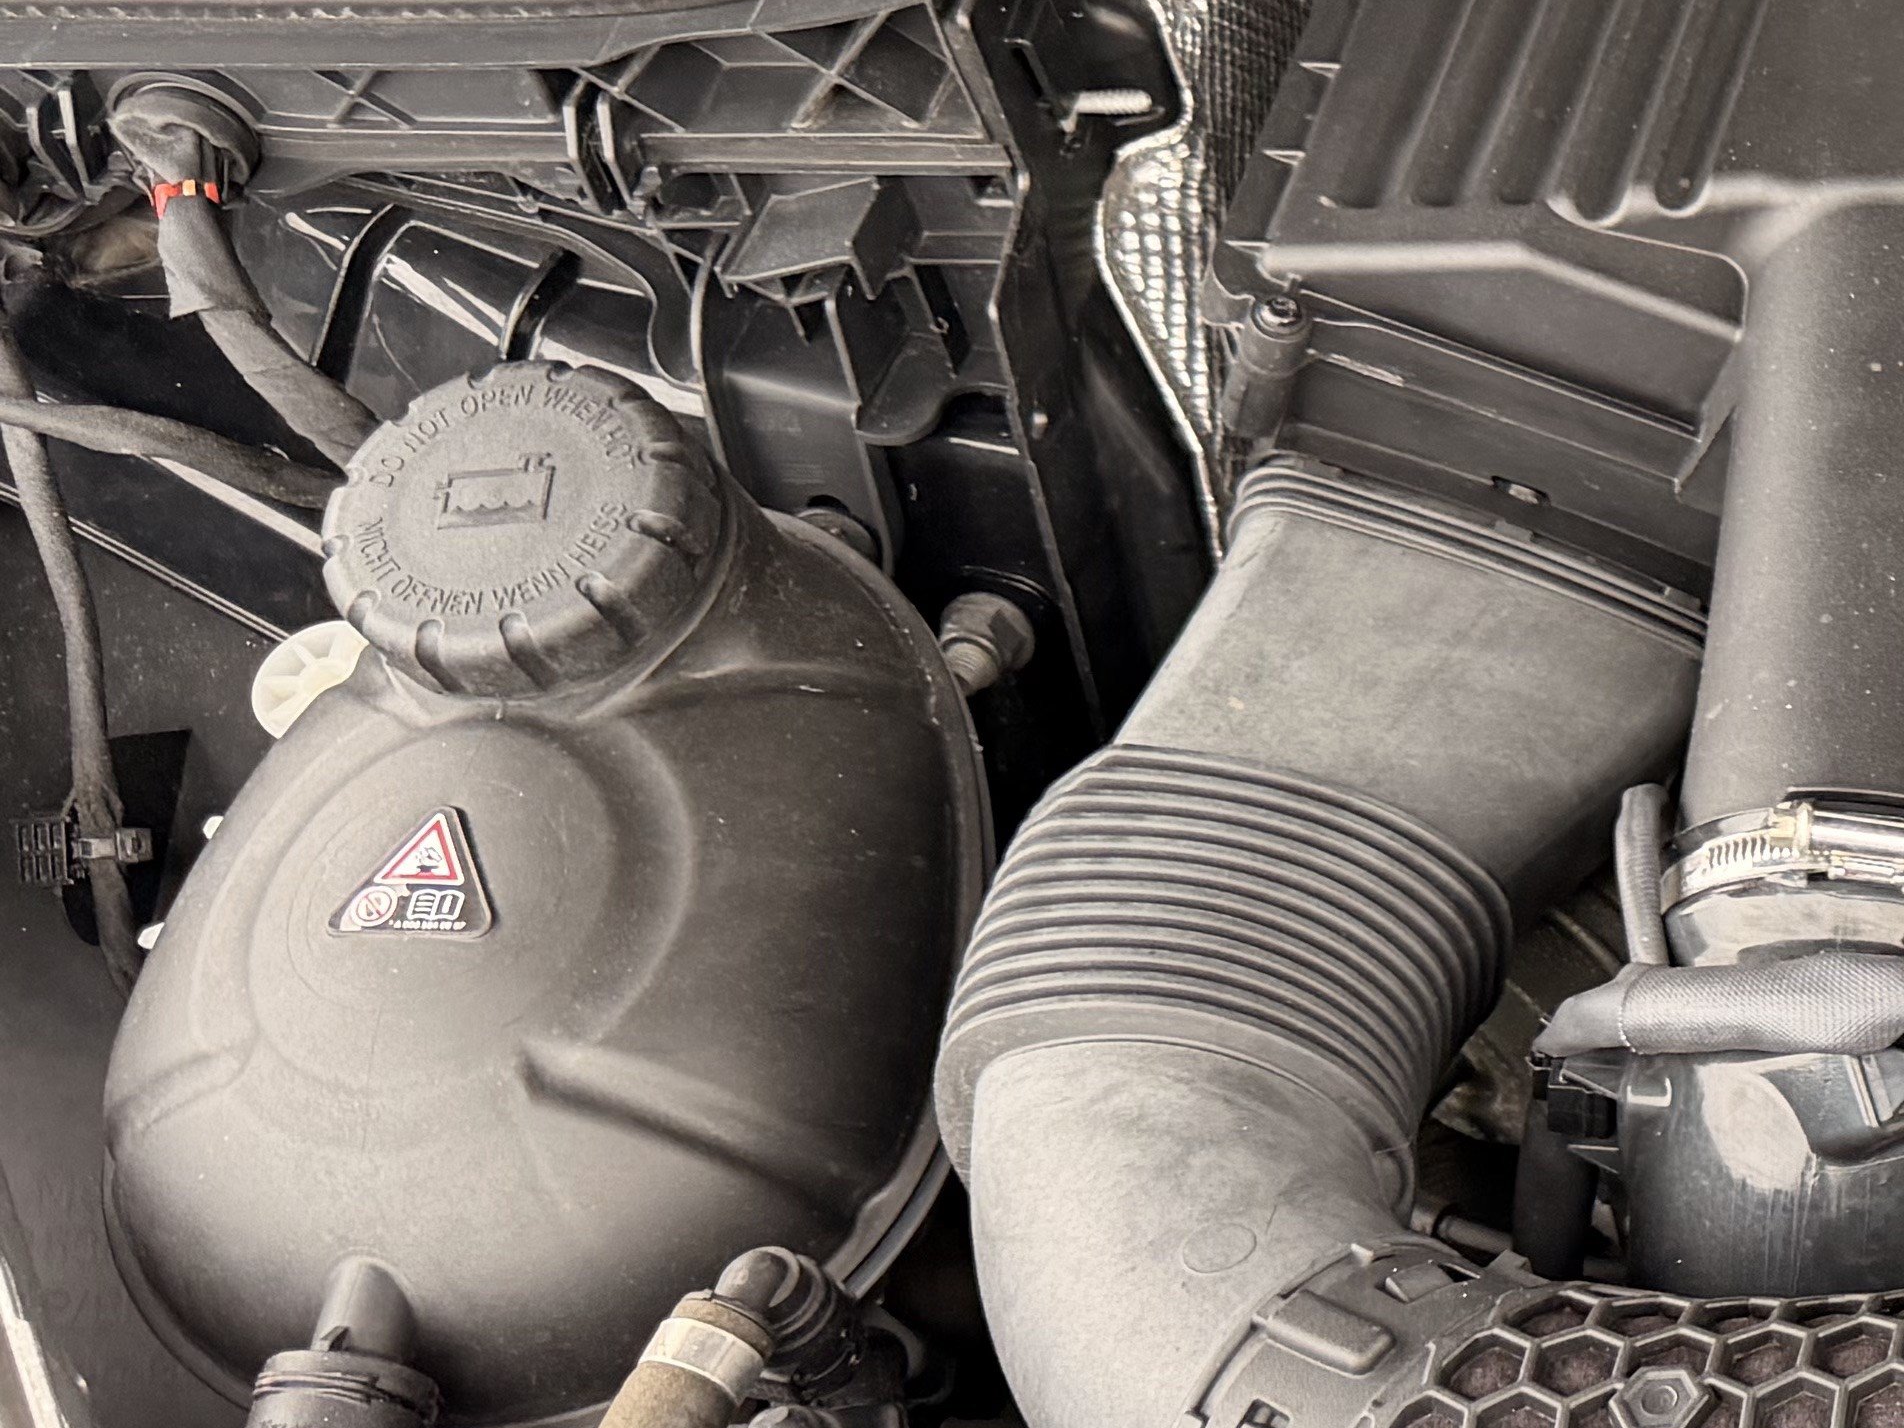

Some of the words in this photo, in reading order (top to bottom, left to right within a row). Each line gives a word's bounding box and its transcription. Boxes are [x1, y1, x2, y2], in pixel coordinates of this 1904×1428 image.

[368, 454, 405, 489] DO
[404, 410, 451, 453] NOT
[460, 384, 535, 419] OPEN
[544, 385, 608, 433] WHEN
[599, 423, 637, 471] HOT
[357, 517, 401, 582] NICHT
[491, 561, 572, 611] WENN
[567, 500, 629, 569] HEISS
